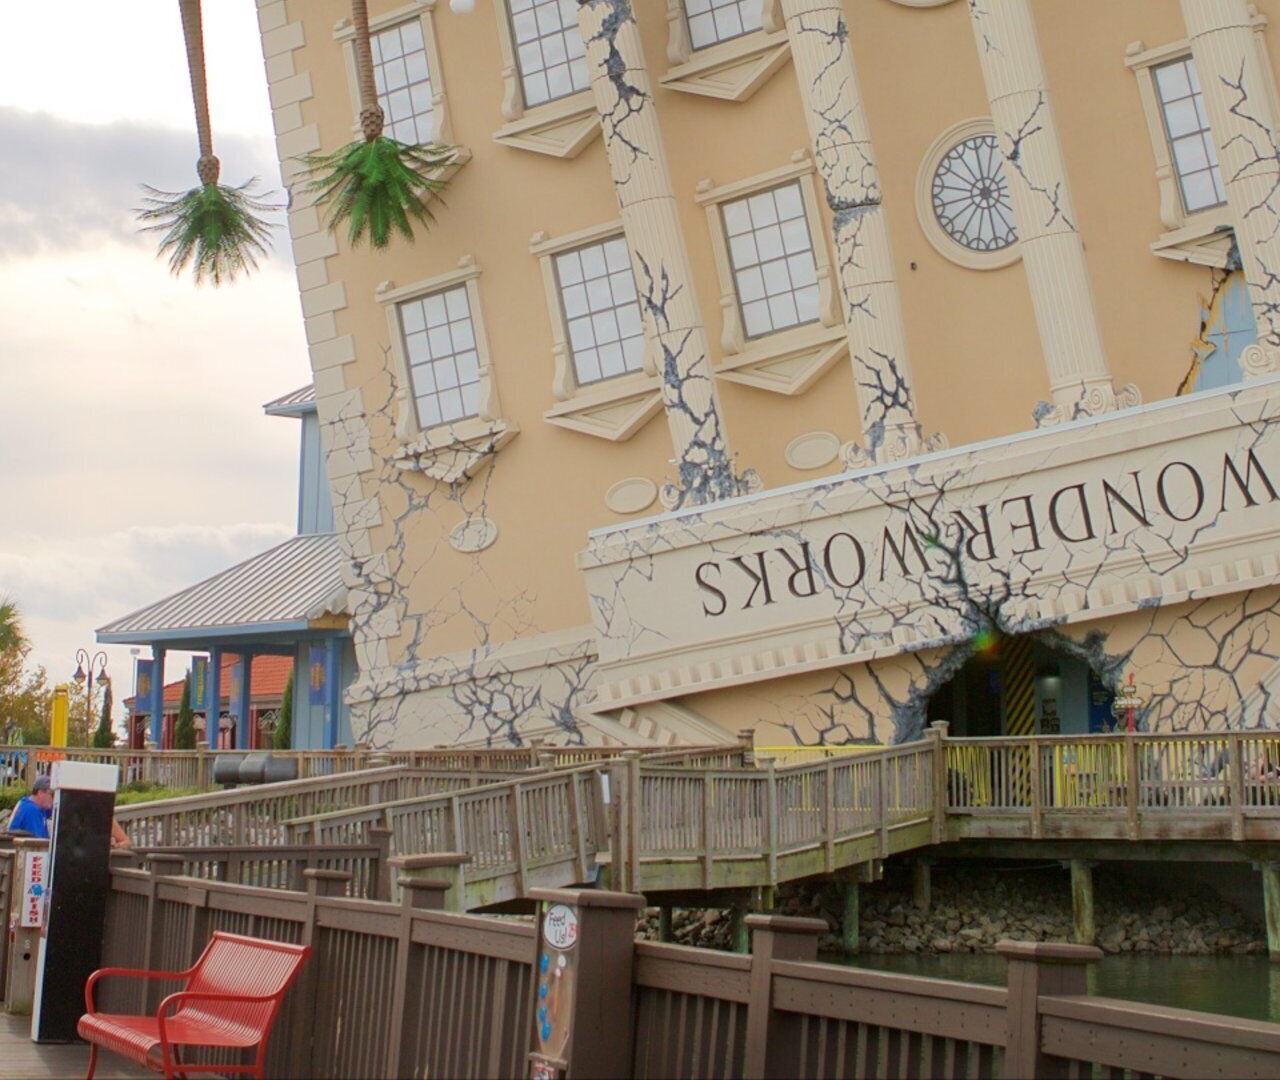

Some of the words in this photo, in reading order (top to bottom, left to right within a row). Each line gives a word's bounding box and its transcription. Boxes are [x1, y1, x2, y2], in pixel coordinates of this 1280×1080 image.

[31, 856, 43, 883] FEED
[29, 897, 39, 923] FISH
[549, 911, 566, 927] Feed
